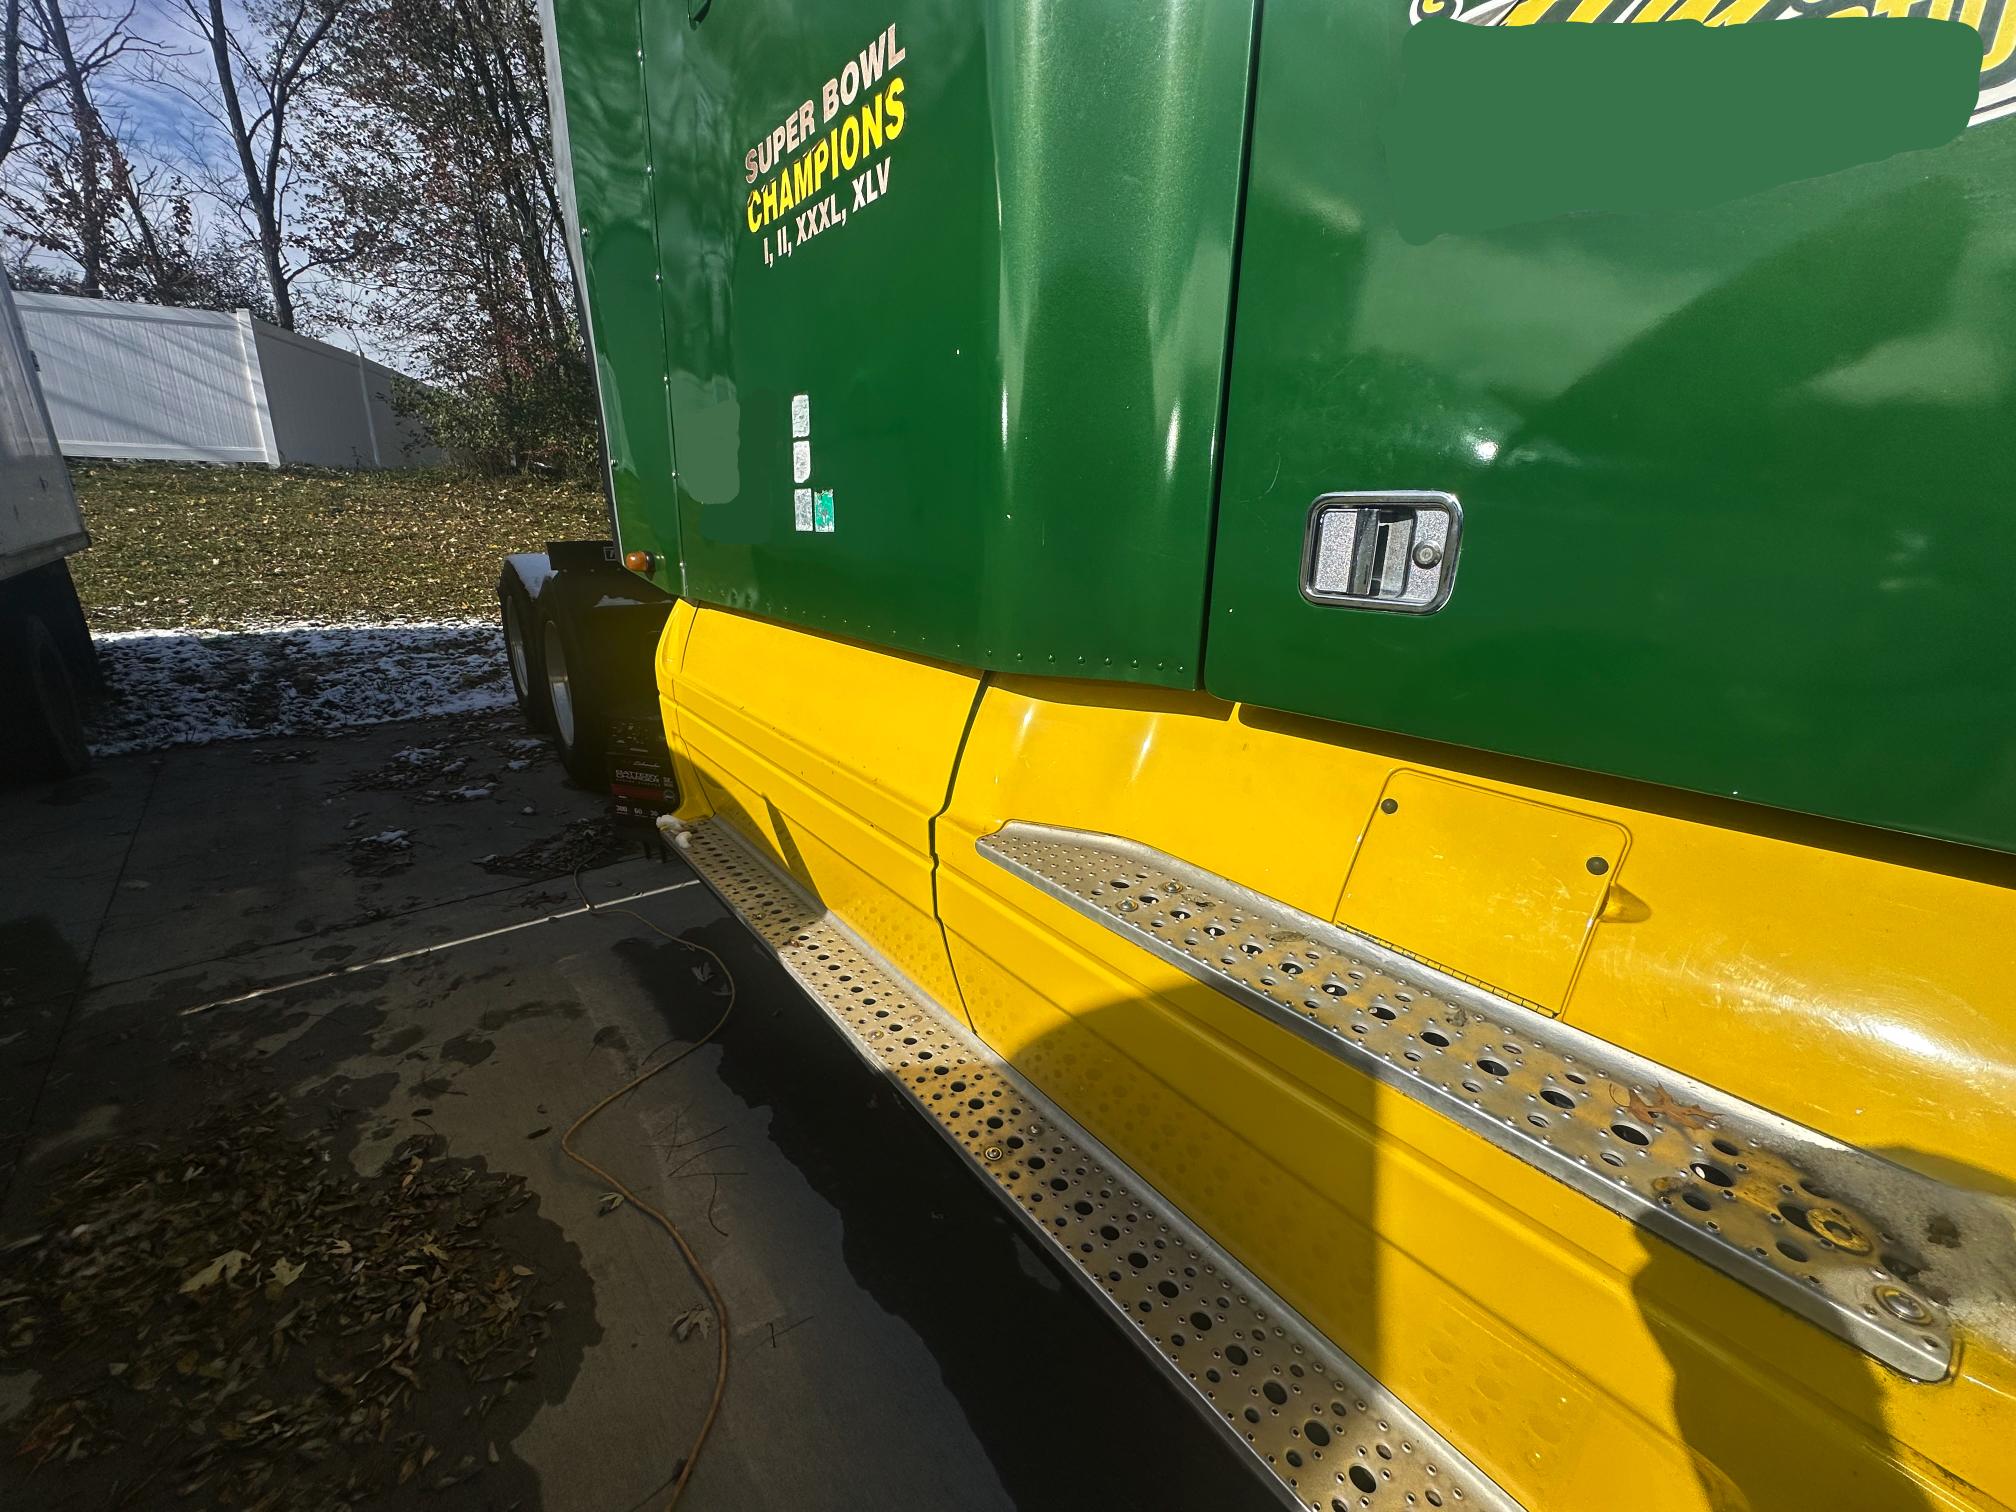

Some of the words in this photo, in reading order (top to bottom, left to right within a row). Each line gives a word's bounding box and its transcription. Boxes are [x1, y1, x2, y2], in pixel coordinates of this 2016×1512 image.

[745, 99, 815, 184] SUPER
[822, 22, 906, 124] BOWL
[747, 77, 905, 233] CHAMPIONS
[763, 237, 773, 268] I,
[777, 225, 792, 257] II,
[795, 193, 847, 246] XXXL,
[852, 156, 891, 213] XLV
